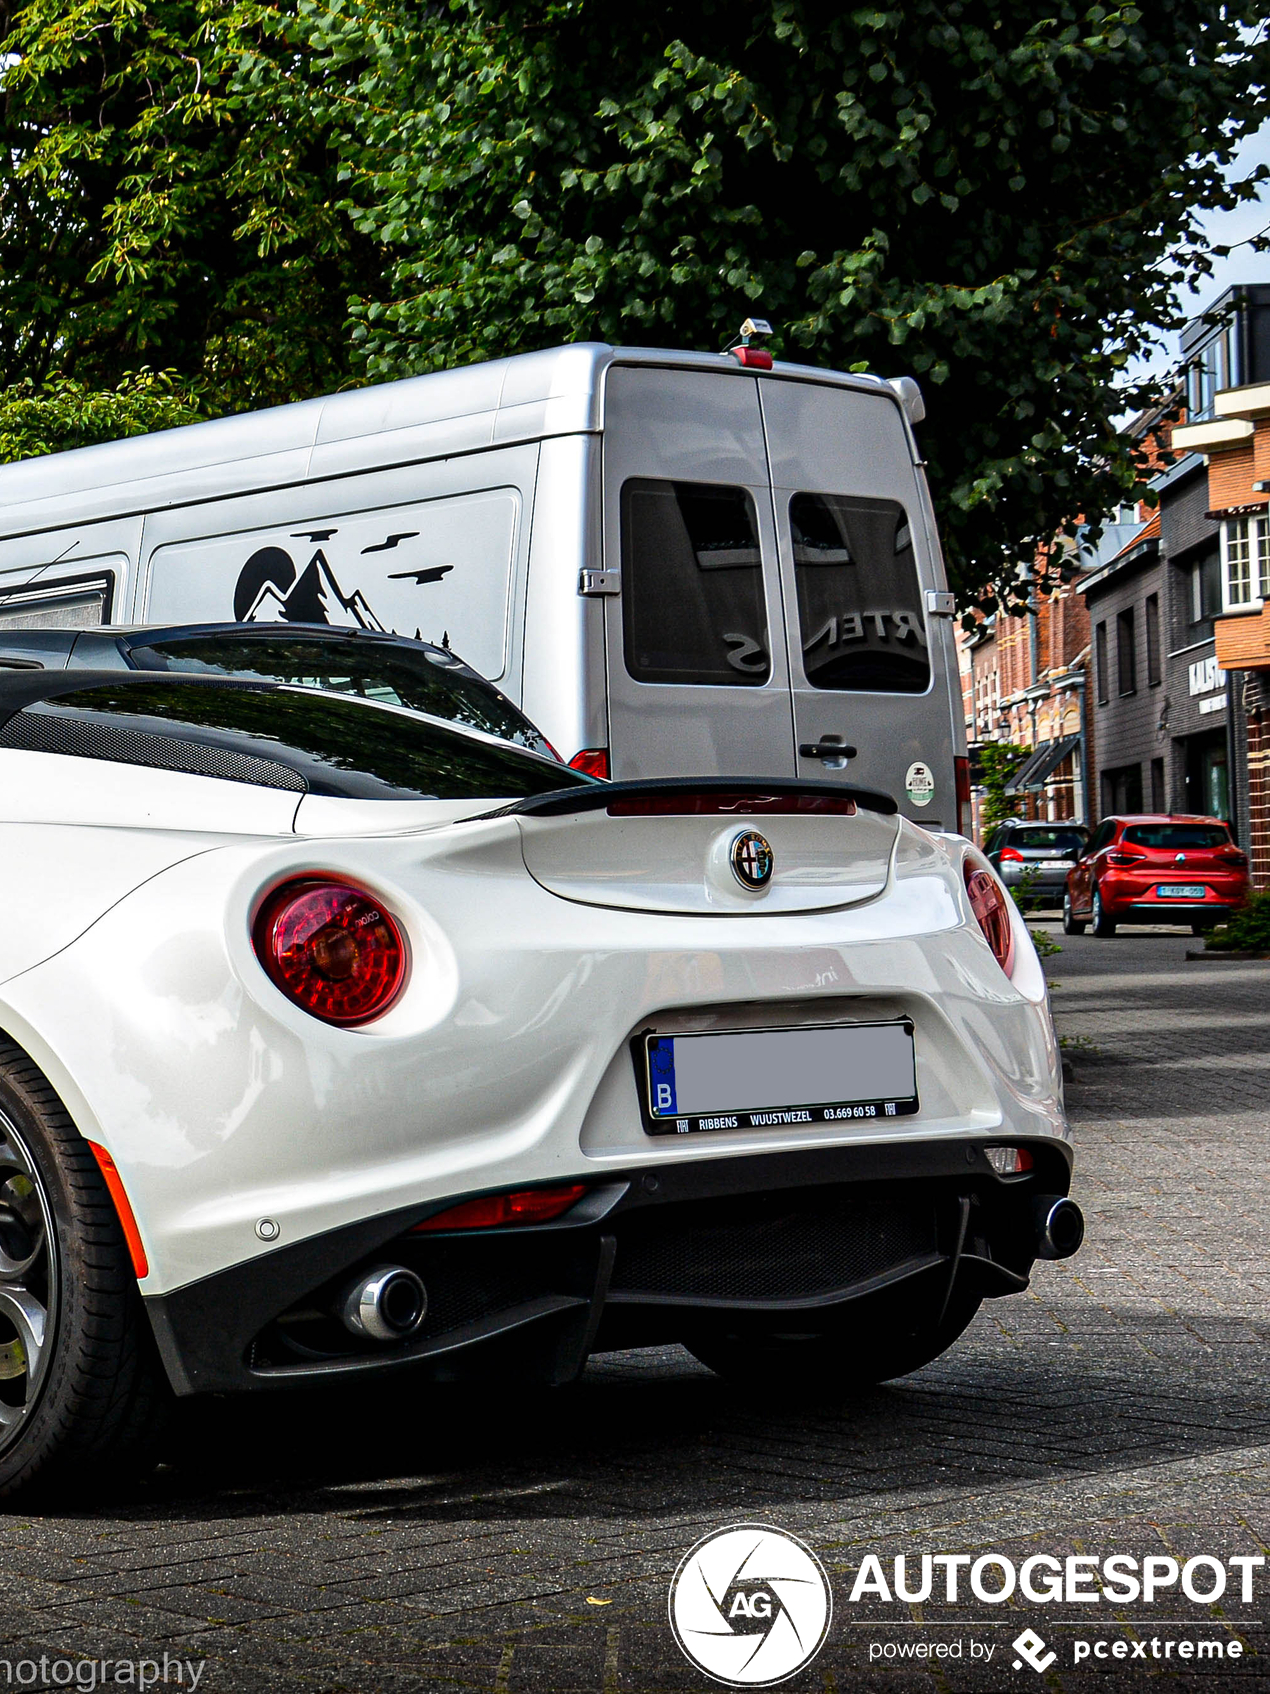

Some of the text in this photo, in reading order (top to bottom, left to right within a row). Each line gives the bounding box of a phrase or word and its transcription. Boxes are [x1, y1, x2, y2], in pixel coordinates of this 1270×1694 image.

[657, 1083, 672, 1108] B
[699, 1116, 738, 1131] RIBBENS
[750, 1110, 812, 1126] WUUSTWEZEL
[824, 1107, 852, 1120] 03.669
[853, 1106, 864, 1117] 60
[865, 1105, 876, 1117] 58
